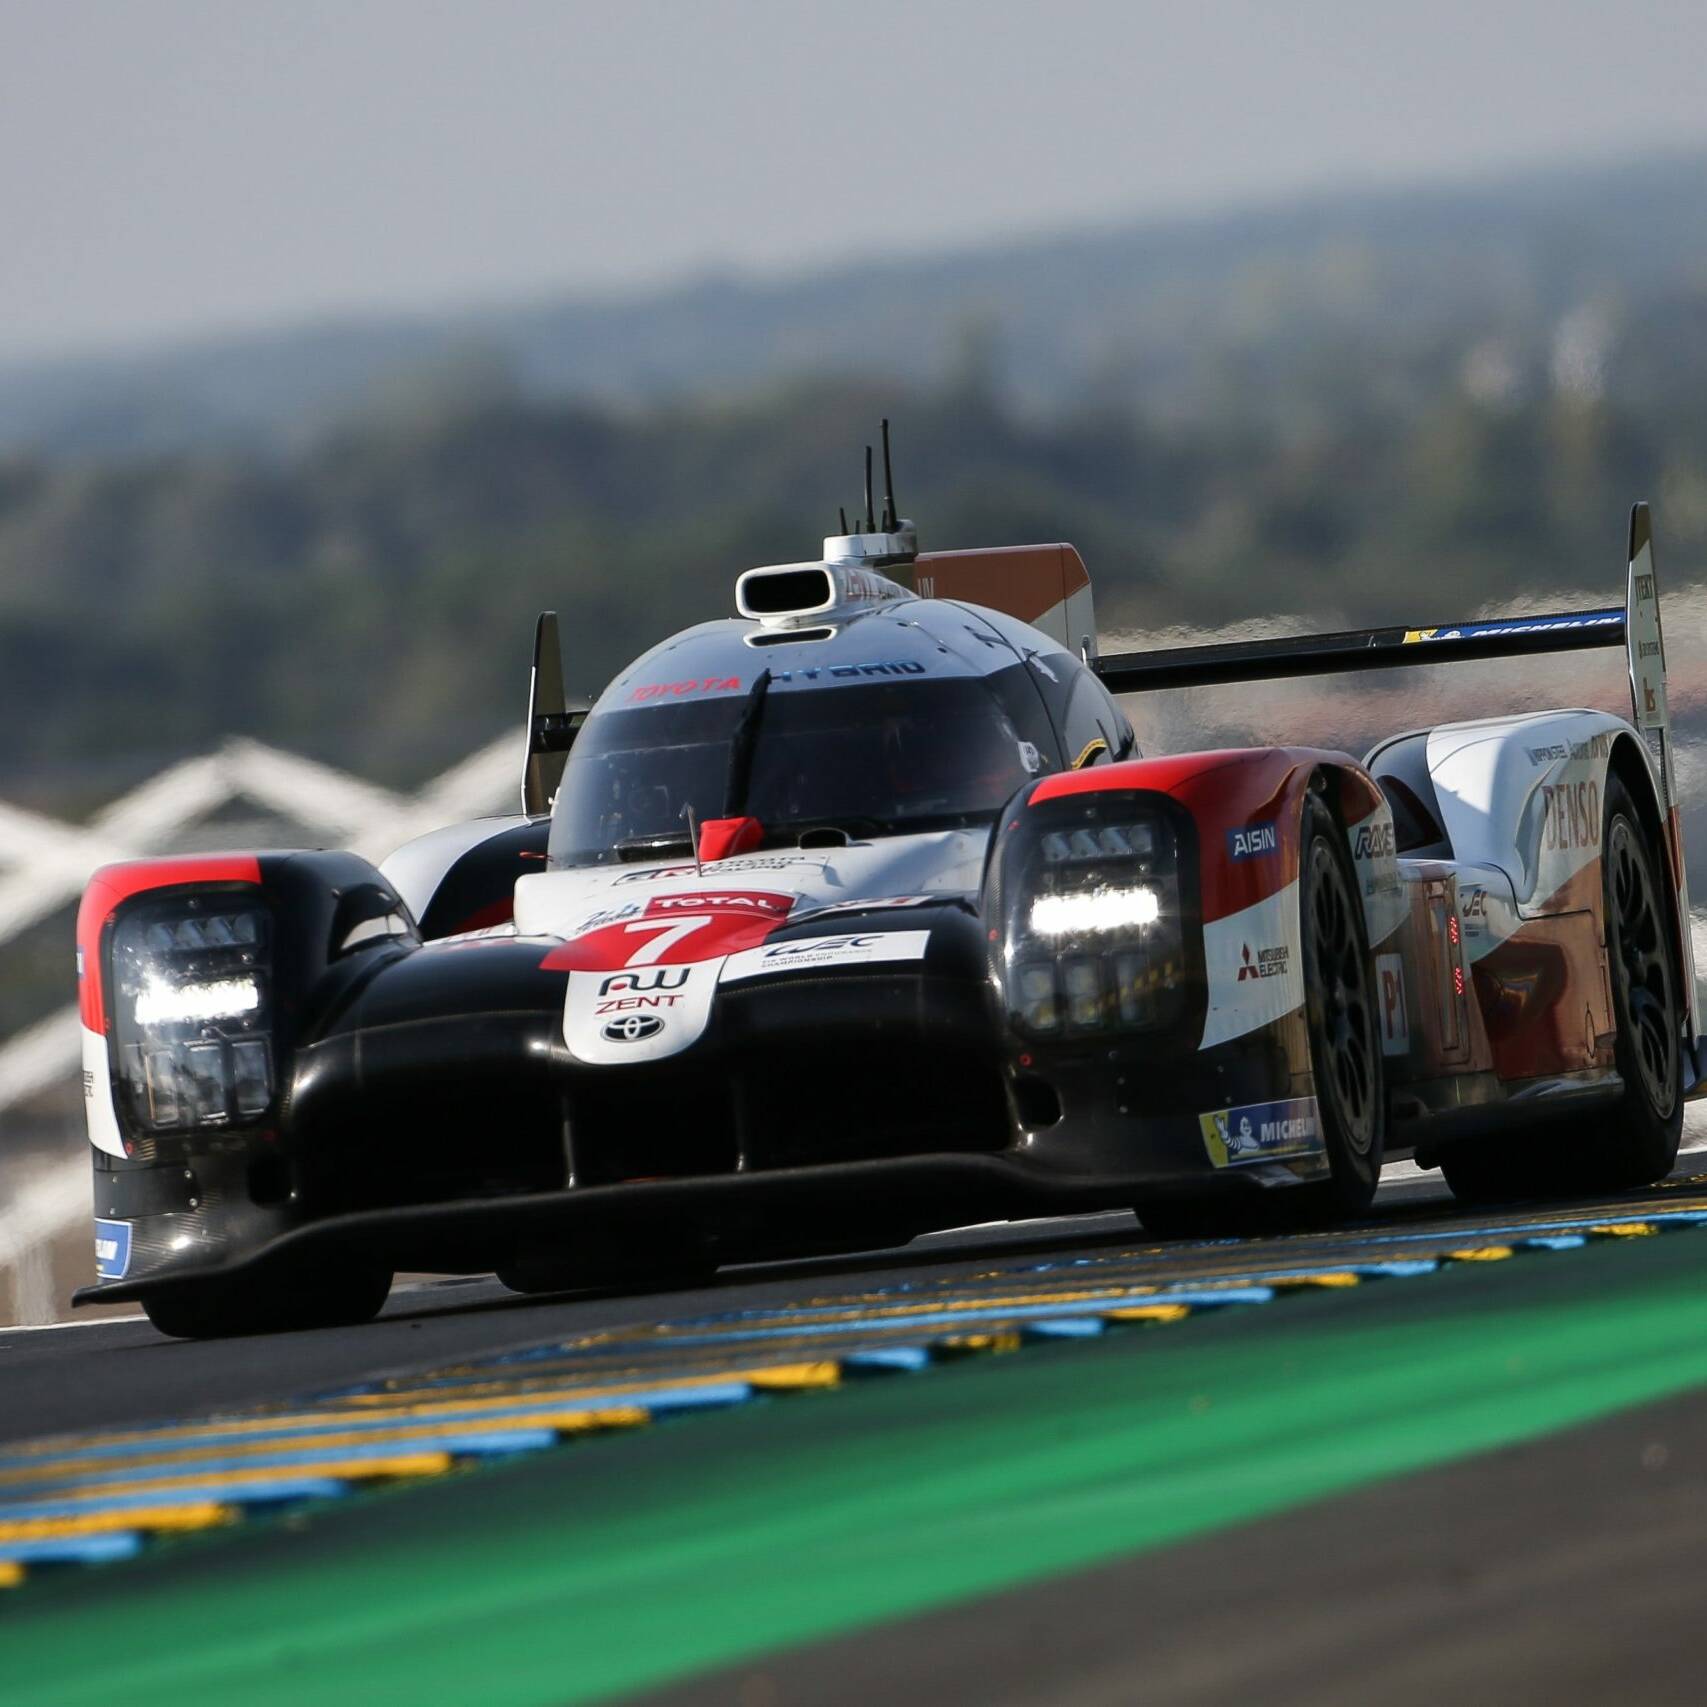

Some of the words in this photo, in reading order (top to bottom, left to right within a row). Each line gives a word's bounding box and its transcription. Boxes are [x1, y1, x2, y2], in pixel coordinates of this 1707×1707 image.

[1471, 616, 1621, 637] MICHELIN
[626, 675, 741, 702] TOYOTA
[771, 660, 926, 683] HYBRID
[1541, 781, 1600, 850] DENSO
[1234, 826, 1276, 857] AISIN
[655, 896, 774, 909] TOTAL
[623, 915, 713, 968] 7
[594, 995, 685, 1015] ZENT
